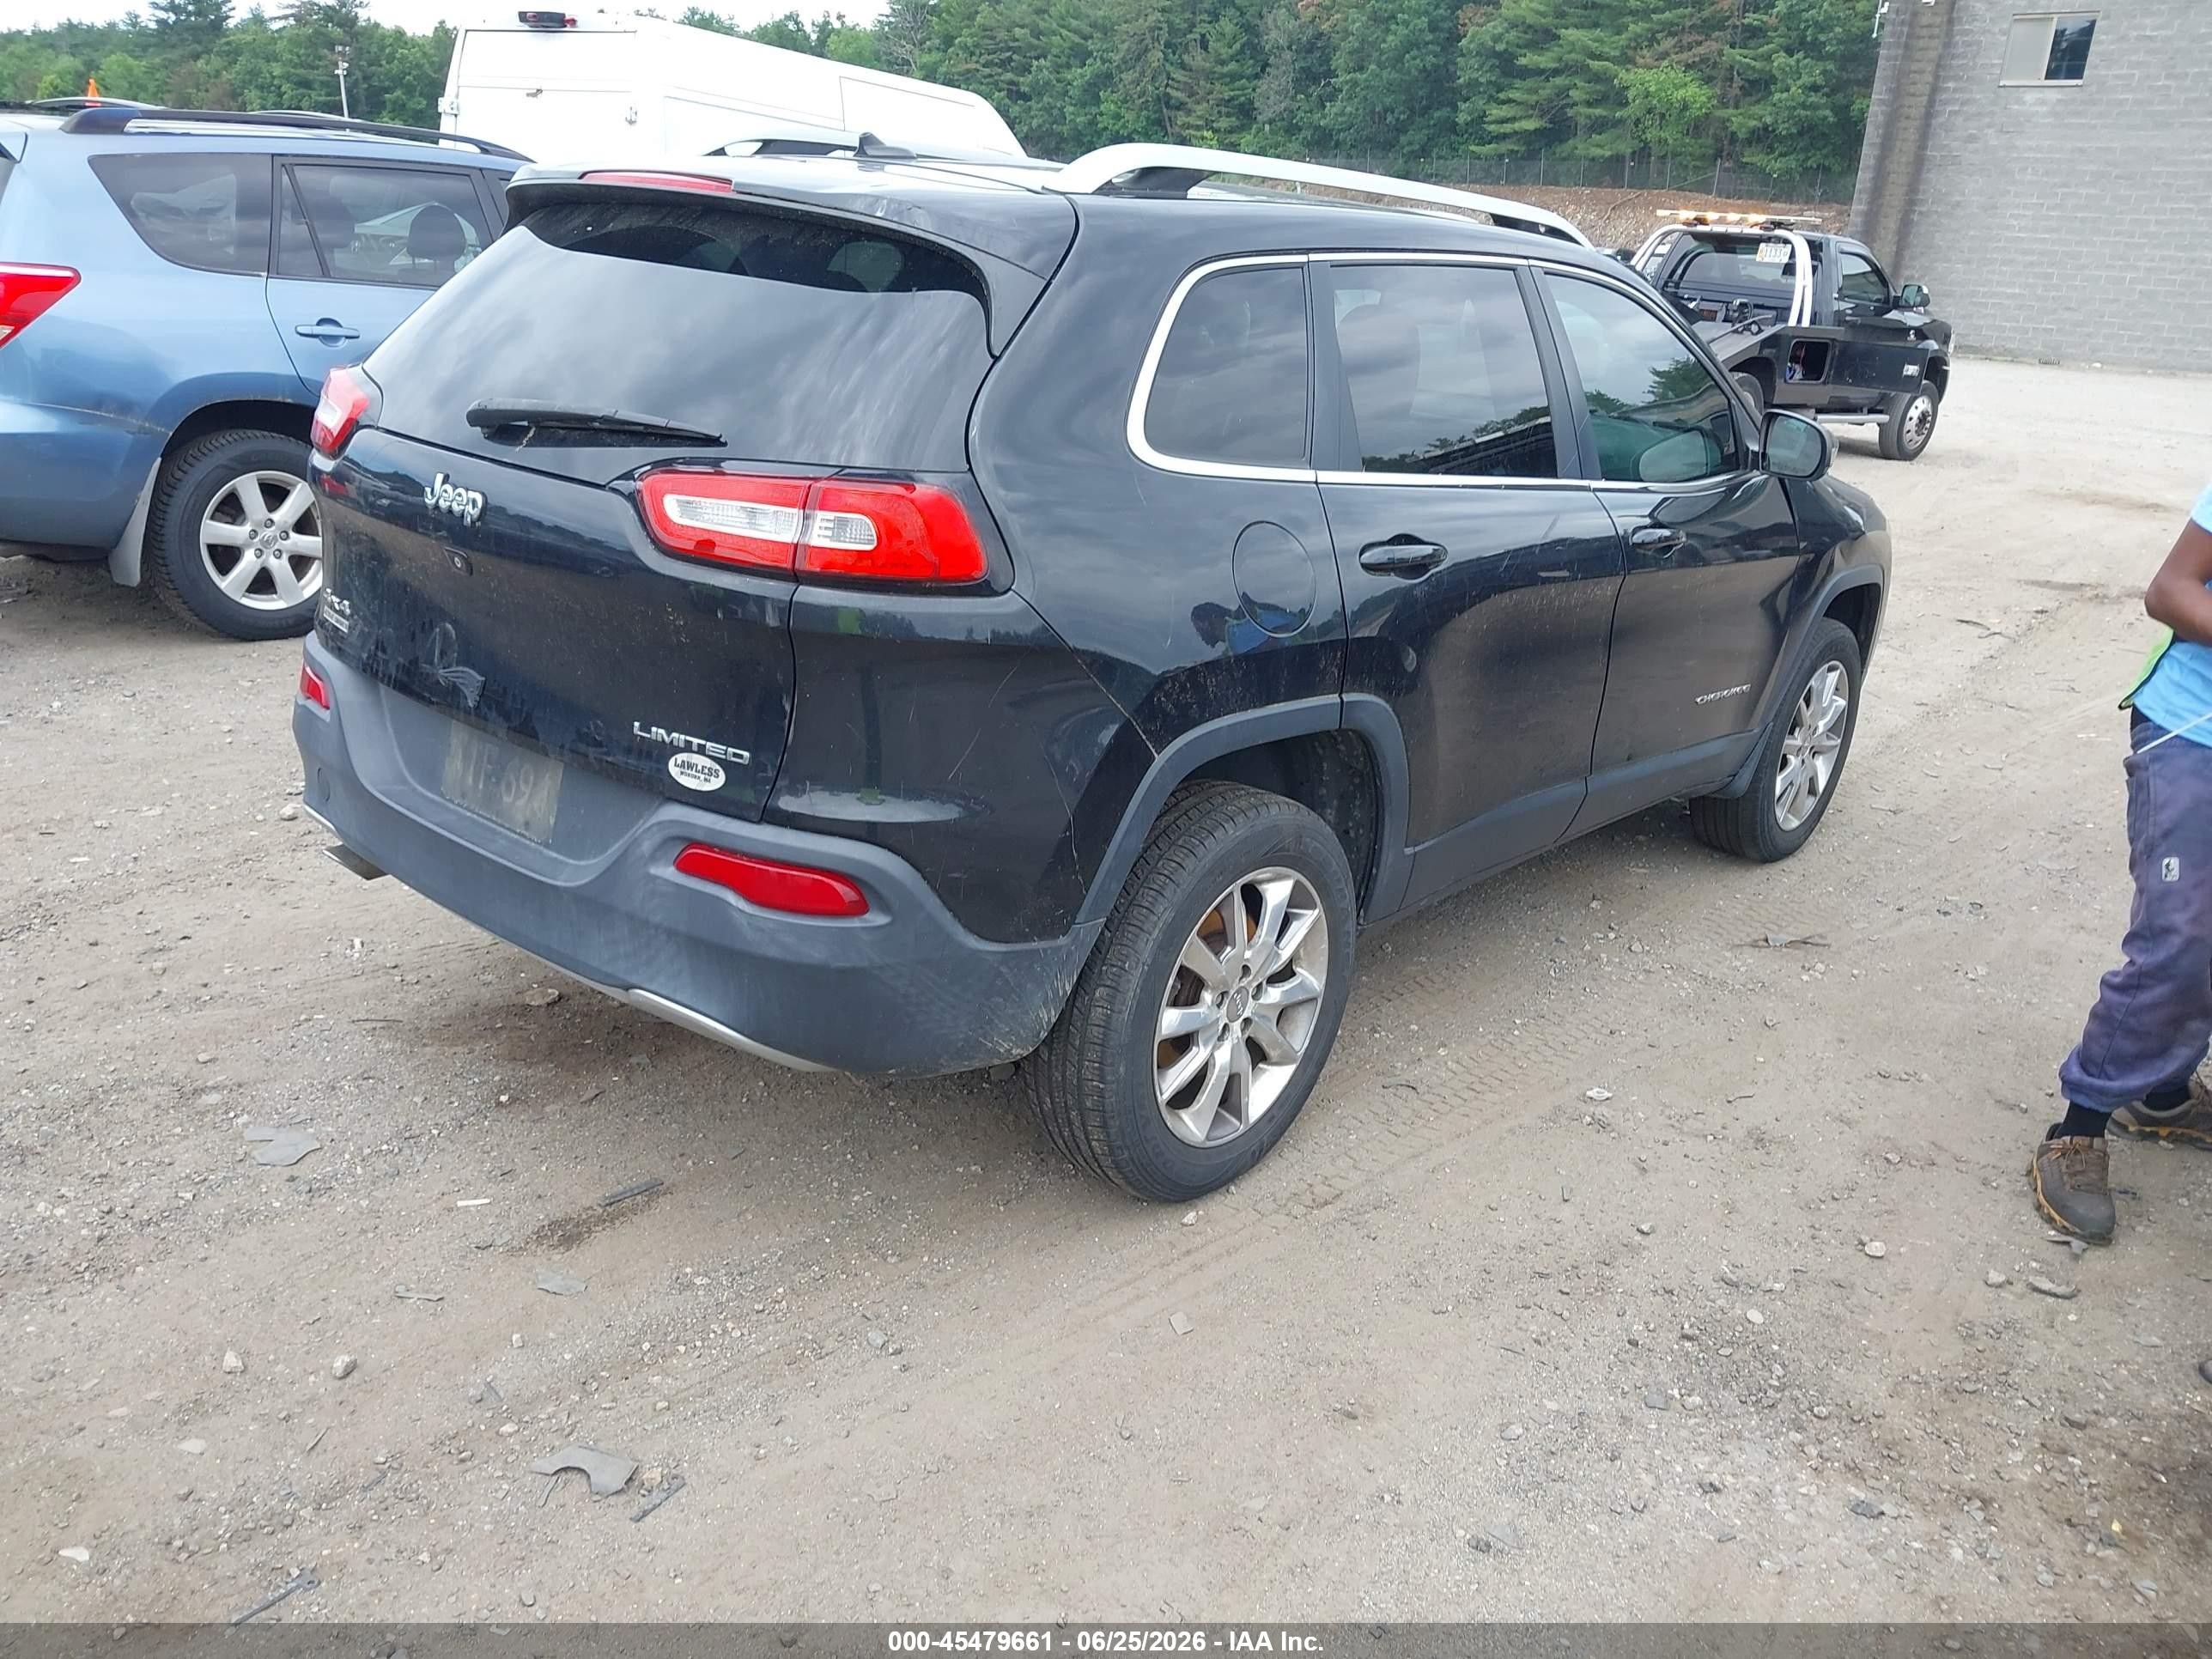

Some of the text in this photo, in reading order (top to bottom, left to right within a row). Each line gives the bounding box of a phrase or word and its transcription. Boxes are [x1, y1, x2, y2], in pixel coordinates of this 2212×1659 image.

[424, 472, 485, 526] Jeep
[1695, 684, 1751, 705] CHEROKEE
[634, 720, 750, 765] LIMITED
[674, 757, 720, 779] LAWLESS
